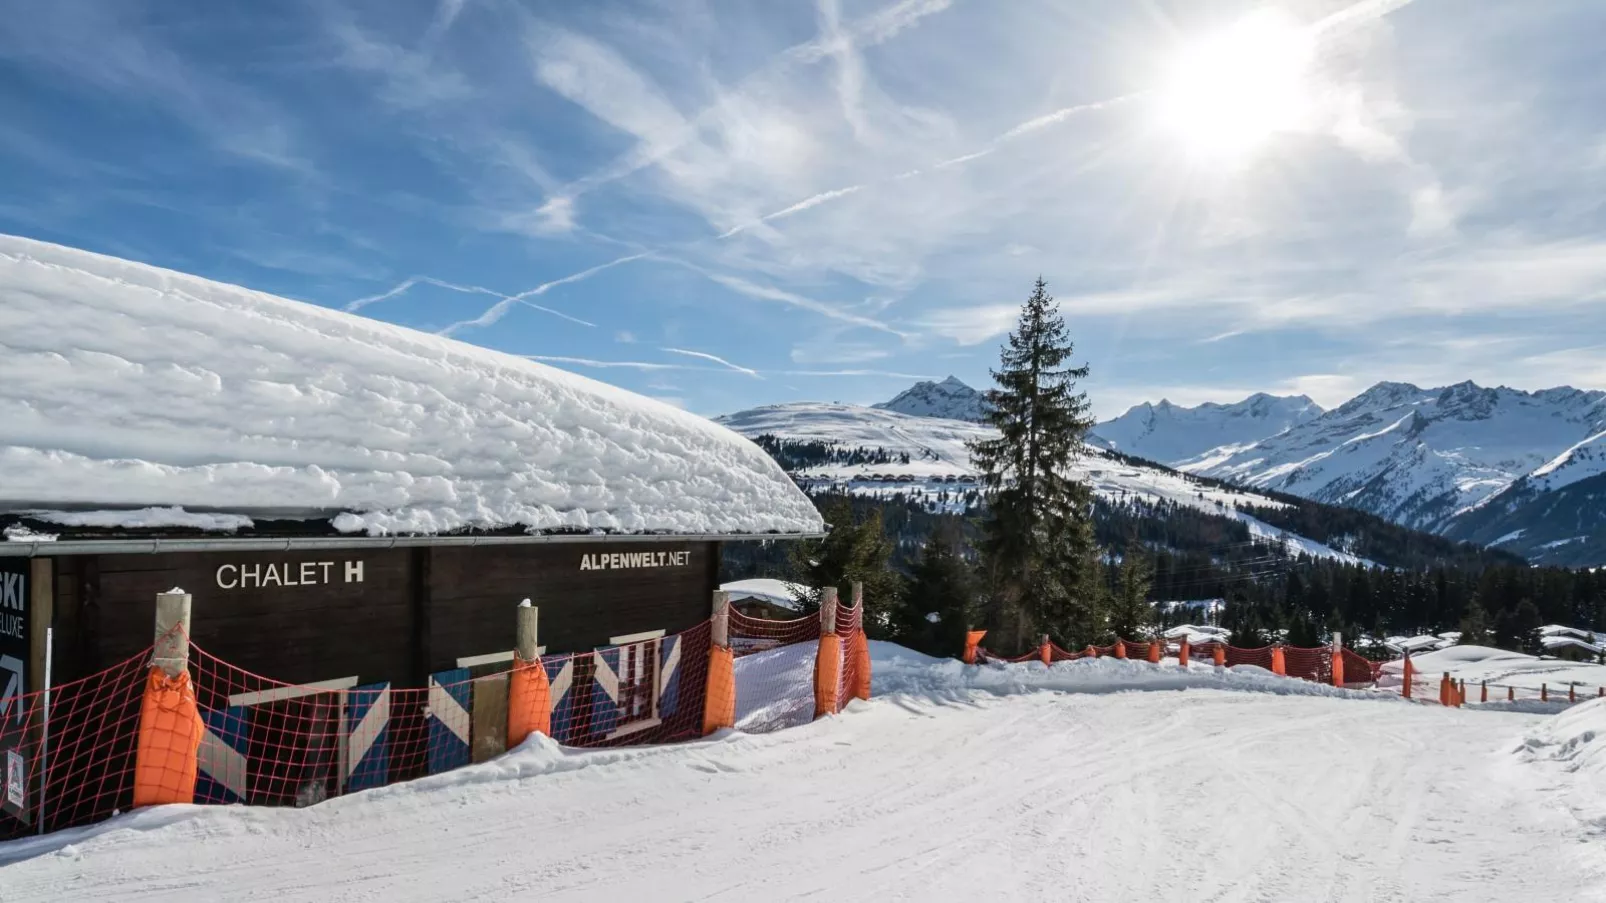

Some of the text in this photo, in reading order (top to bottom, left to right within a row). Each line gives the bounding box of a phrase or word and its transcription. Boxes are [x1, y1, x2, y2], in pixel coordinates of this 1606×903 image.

[580, 551, 690, 570] ALPENWELT.NET
[216, 561, 363, 589] CHALET H
[0, 572, 24, 610] KI
[0, 613, 24, 639] LUXE
